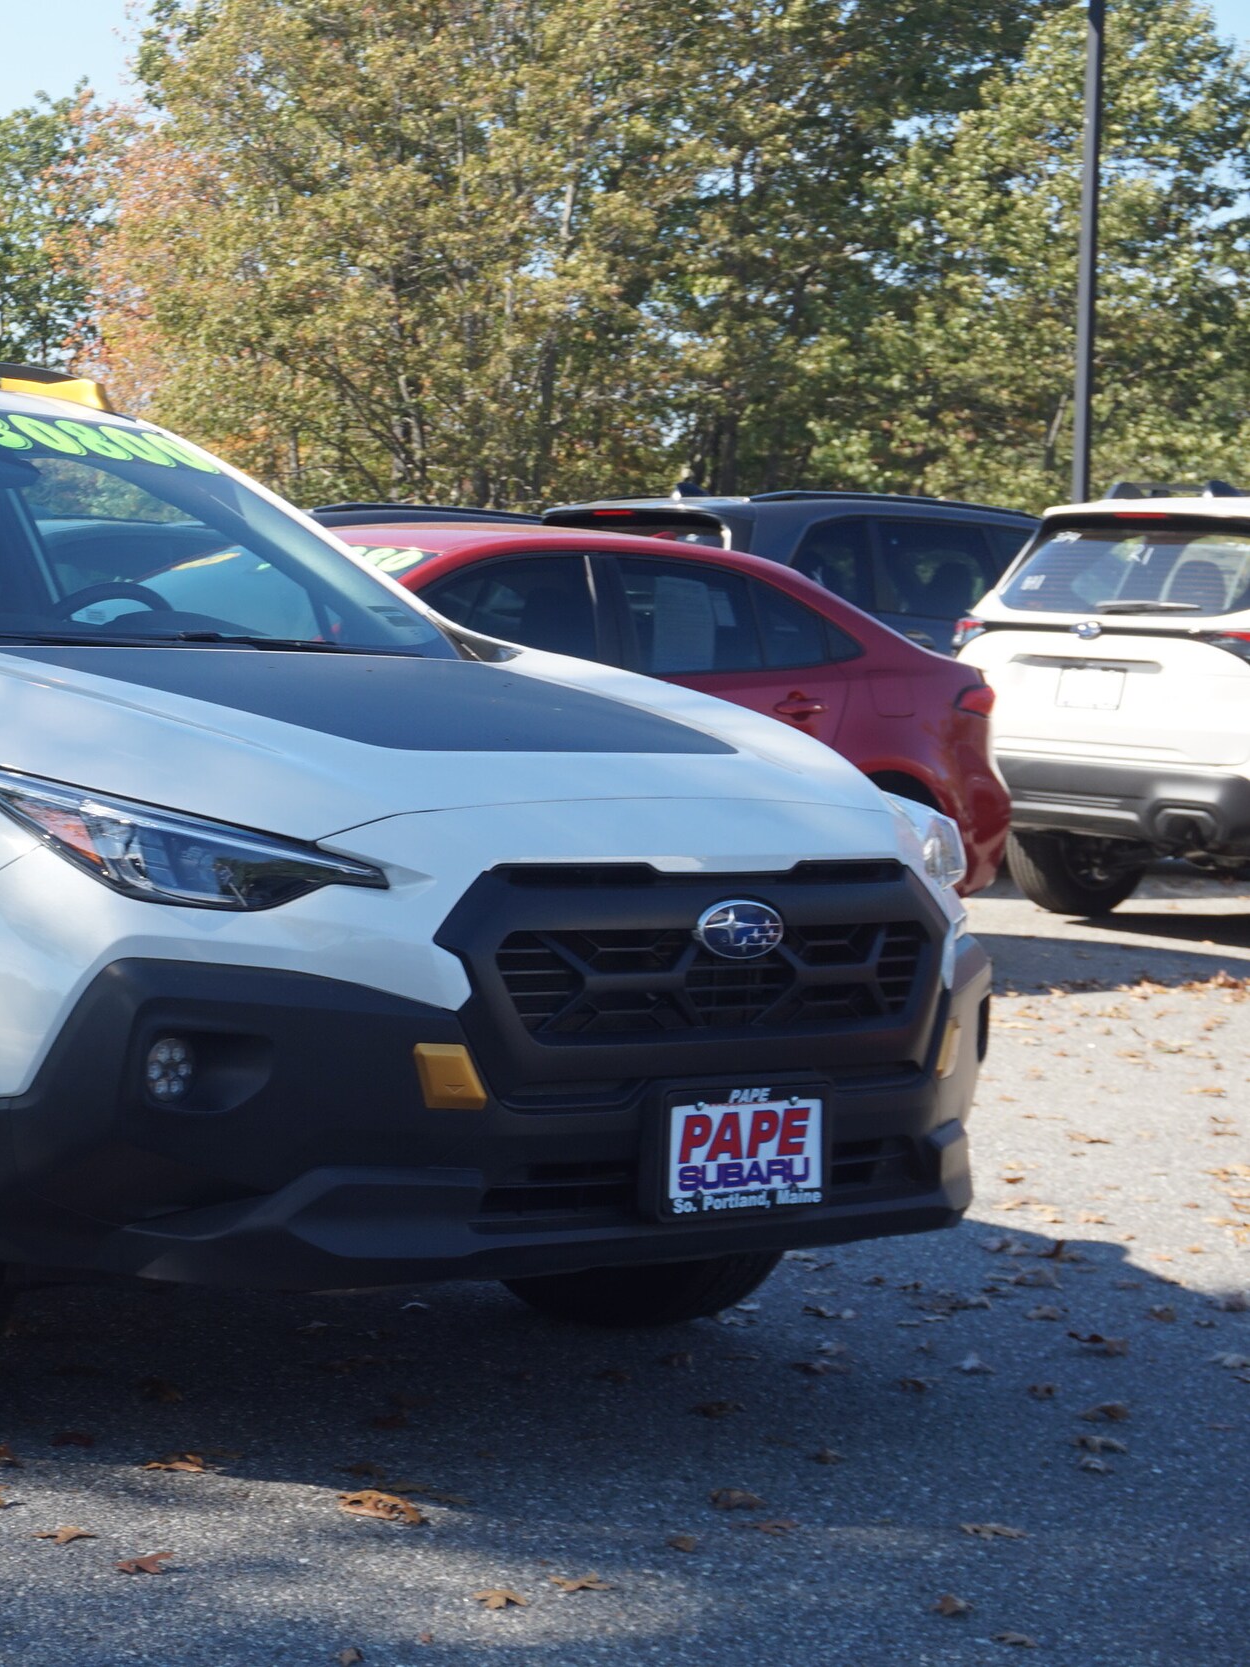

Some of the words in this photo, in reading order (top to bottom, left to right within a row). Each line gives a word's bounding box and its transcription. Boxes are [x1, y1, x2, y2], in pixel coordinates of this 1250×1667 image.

[728, 1087, 771, 1103] PAPE
[678, 1107, 811, 1164] PAPE
[678, 1157, 810, 1192] SUBARU
[673, 1199, 698, 1213] So.
[702, 1191, 771, 1211] Portland,
[776, 1189, 822, 1205] Maine
